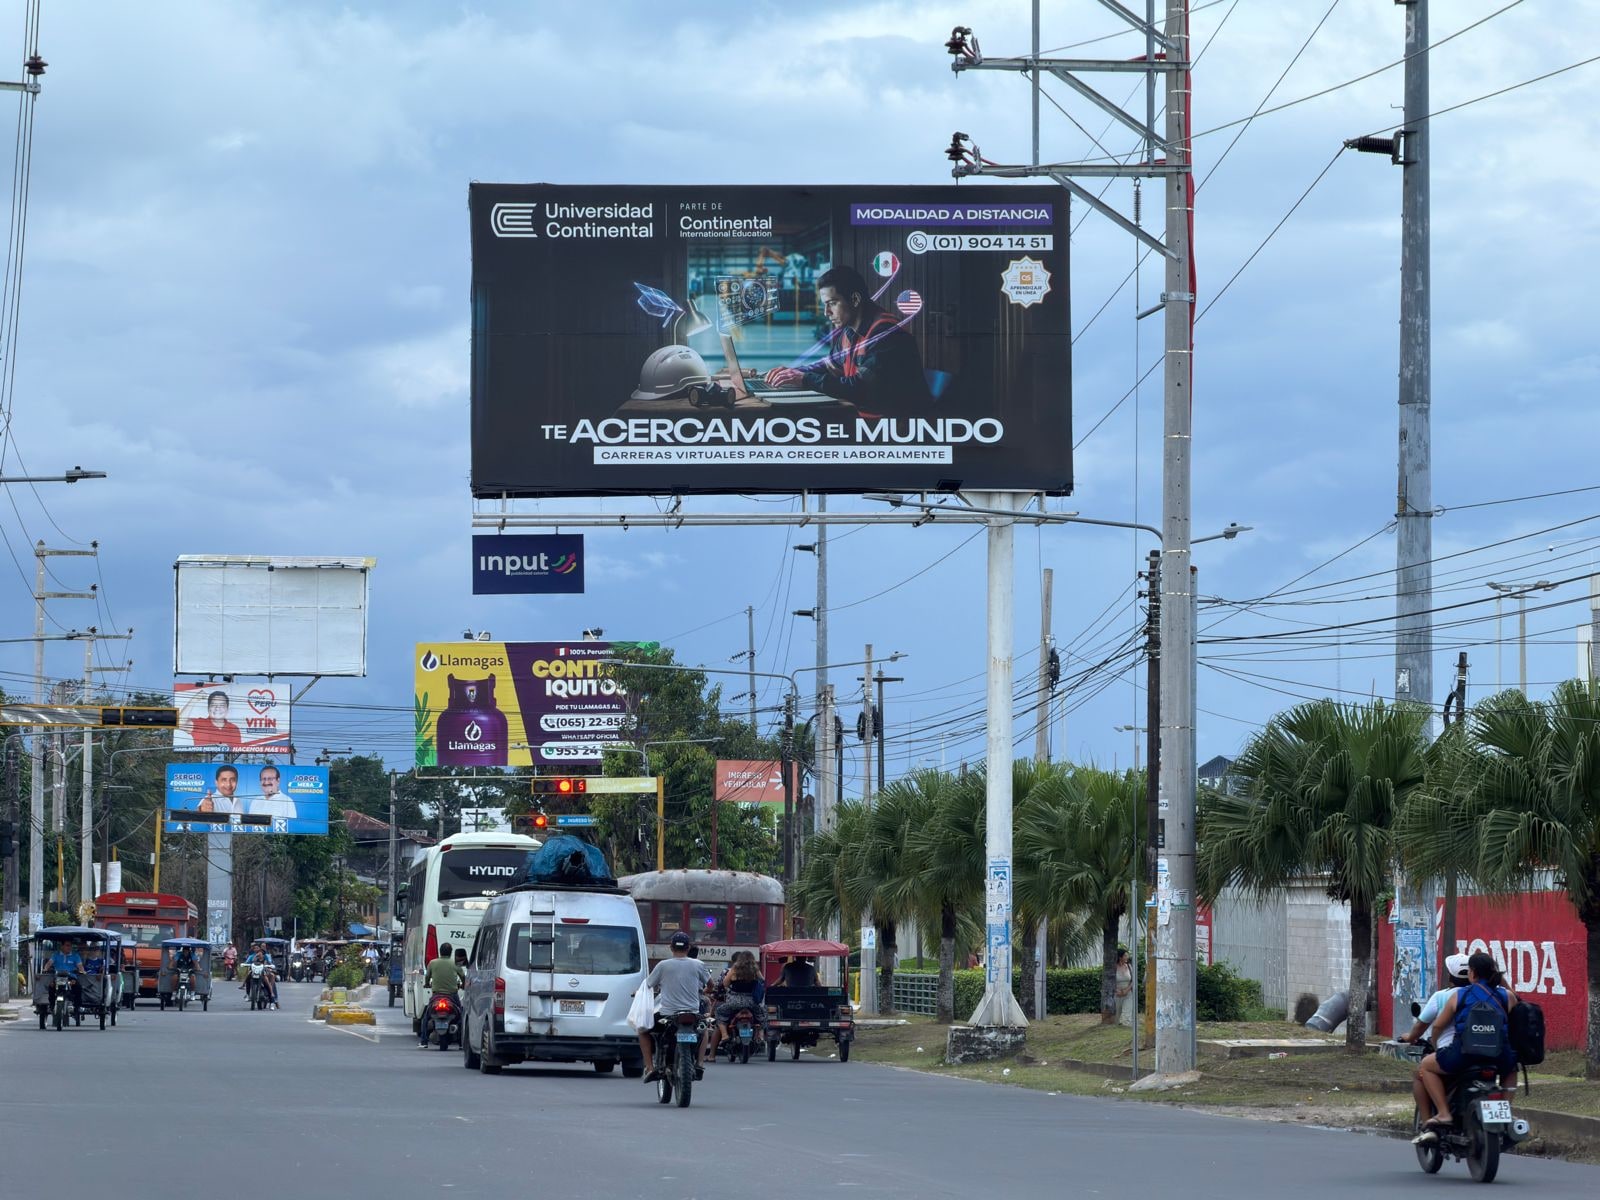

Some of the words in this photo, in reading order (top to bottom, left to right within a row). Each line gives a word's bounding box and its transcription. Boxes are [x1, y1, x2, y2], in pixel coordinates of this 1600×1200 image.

[545, 203, 653, 219] Universidad
[680, 203, 707, 211] PARTE
[856, 209, 950, 220] MODALIDAD
[952, 209, 964, 220] A
[967, 209, 1050, 220] DISTANCIA
[679, 215, 772, 230] Continental
[545, 222, 653, 238] Continental
[680, 230, 731, 238] International
[732, 230, 772, 238] Education
[932, 236, 963, 250] (01)
[968, 237, 1004, 249] 904
[1007, 237, 1026, 248] 14
[1030, 237, 1047, 248] 51
[541, 425, 567, 440] TE
[569, 417, 822, 444] ACERCAMOS
[826, 423, 850, 439] EL
[855, 417, 1004, 443] MUNDO
[601, 451, 672, 460] CARRERAS
[676, 451, 745, 460] VIRTUALES
[749, 451, 784, 459] PARA
[787, 450, 840, 459] CRECER
[843, 450, 945, 459] LABORALMENTE
[439, 654, 504, 669] Llamagas
[556, 717, 586, 729] (065)
[448, 741, 496, 752] Llamagas
[469, 865, 518, 876] HYUND
[450, 930, 466, 939] TSL
